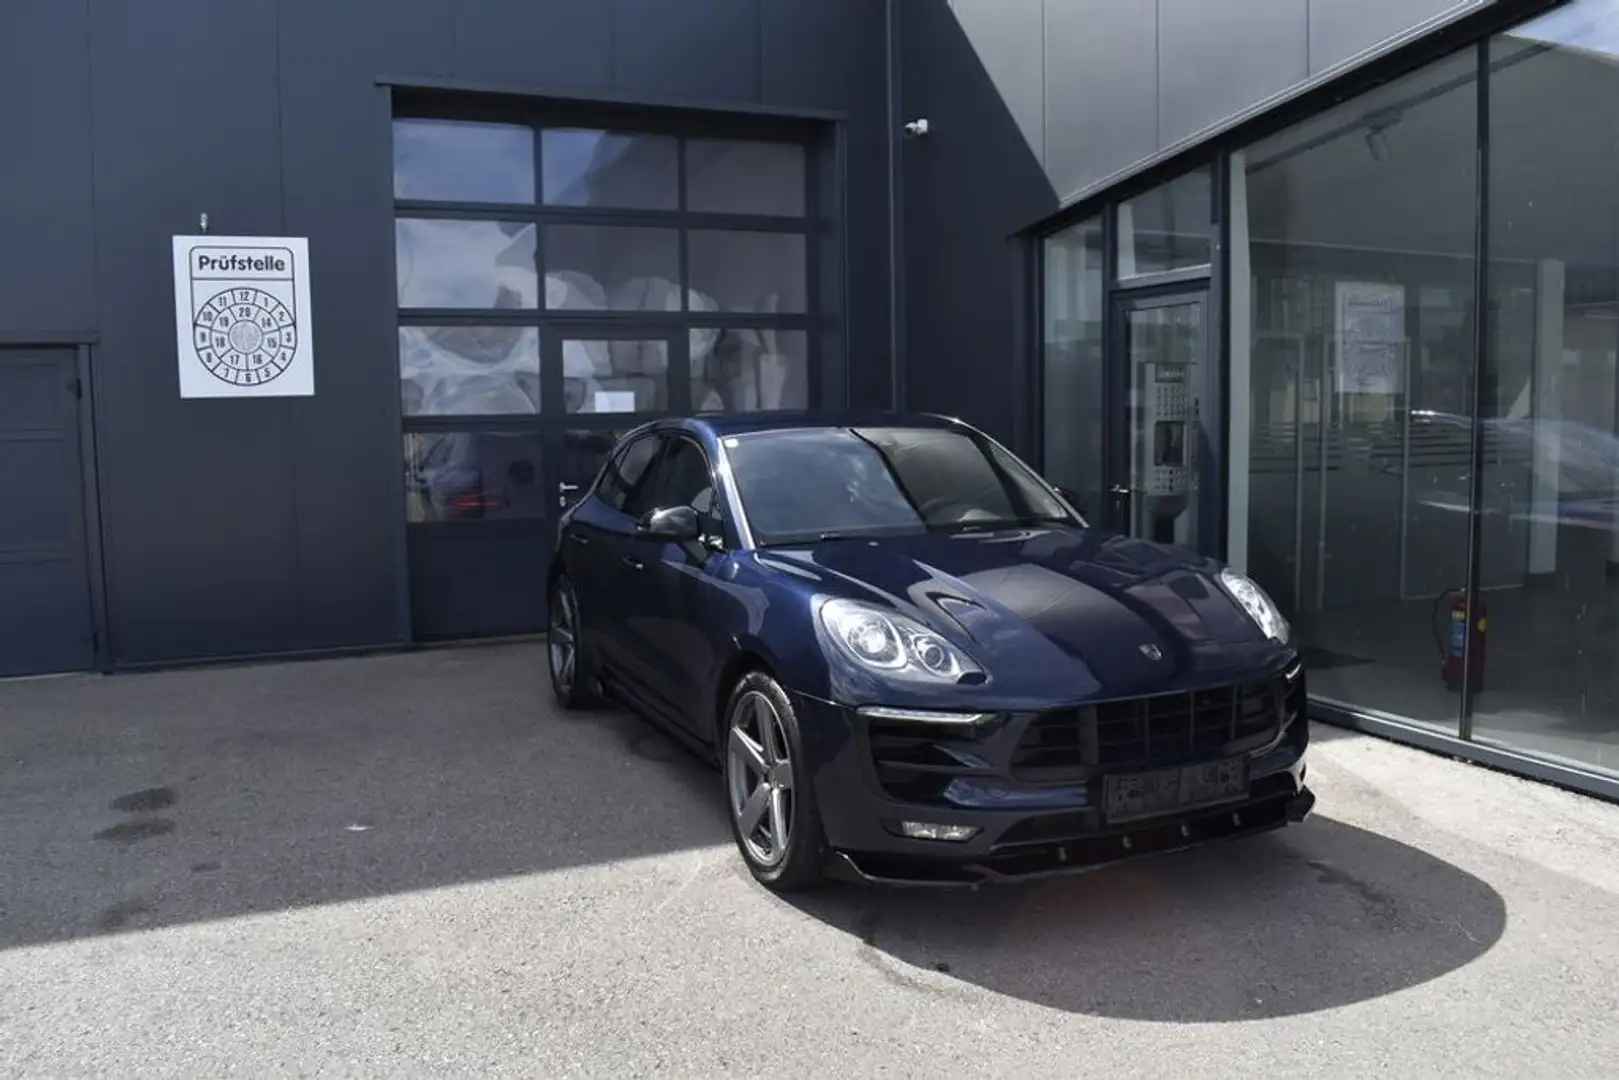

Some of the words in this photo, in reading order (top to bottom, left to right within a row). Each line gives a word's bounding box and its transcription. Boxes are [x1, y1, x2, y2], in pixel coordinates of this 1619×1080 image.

[199, 255, 285, 271] Prüfstelle
[240, 291, 249, 301] 12
[203, 312, 212, 321] 10
[239, 308, 250, 317] 20
[278, 311, 284, 321] 2
[261, 317, 271, 327] 14
[268, 337, 277, 347] 15
[285, 332, 292, 342] 3
[230, 354, 239, 365] 17
